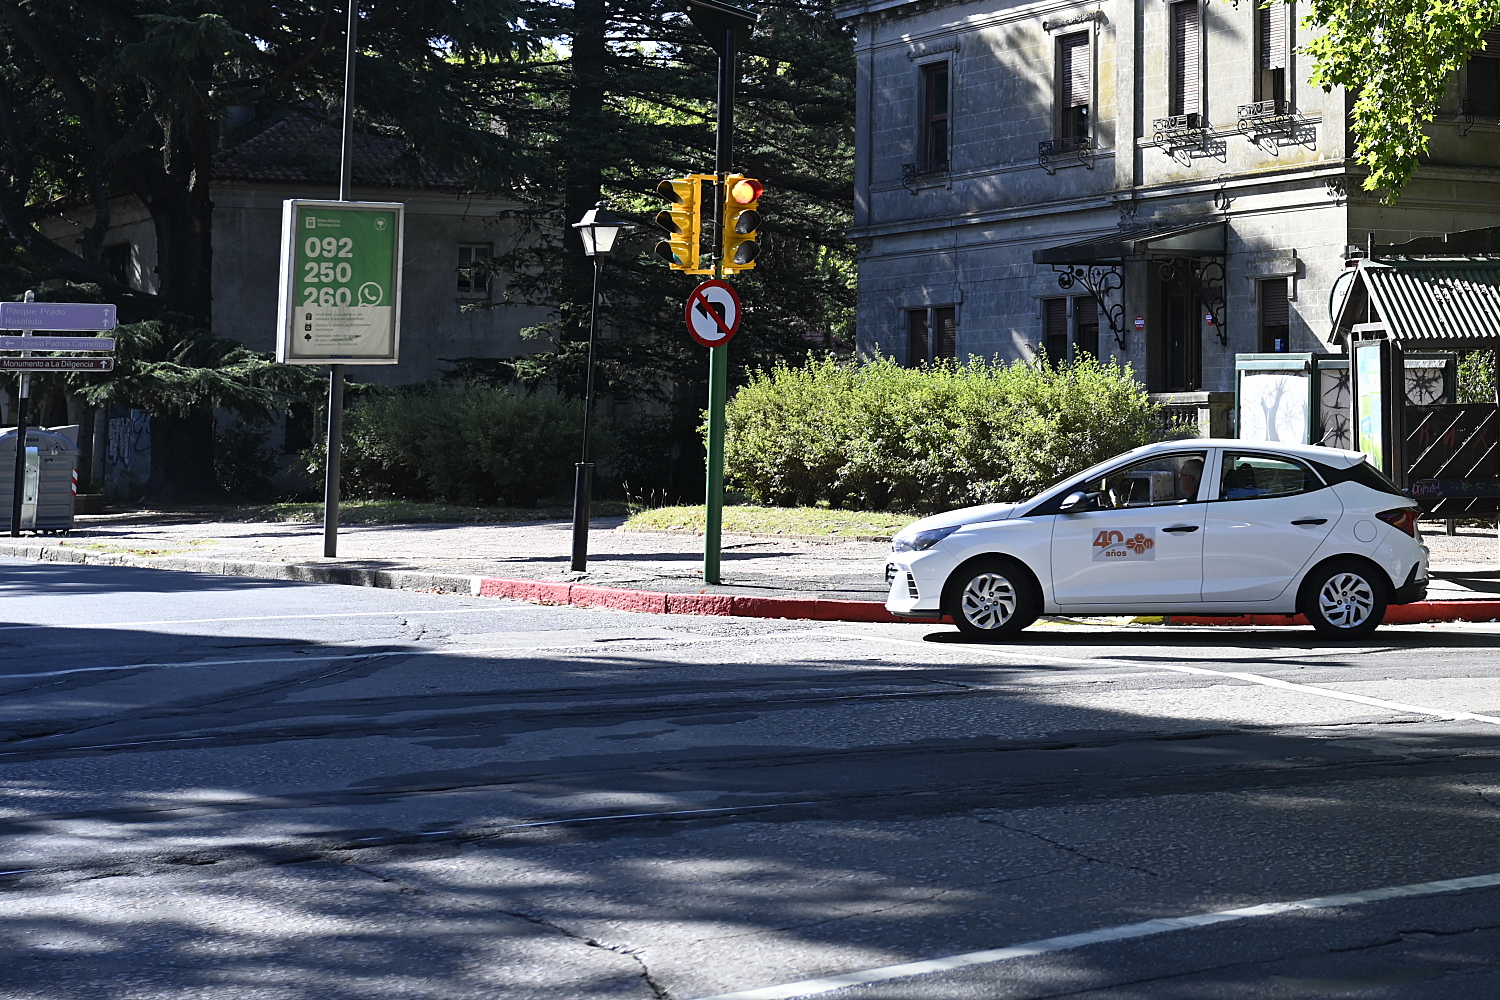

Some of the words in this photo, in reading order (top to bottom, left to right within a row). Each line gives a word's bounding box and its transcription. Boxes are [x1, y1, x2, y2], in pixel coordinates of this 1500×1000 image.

[305, 237, 353, 258] 092
[303, 262, 352, 283] 250
[303, 286, 352, 307] 260
[6, 307, 37, 316] Parque
[21, 340, 44, 348] Iglesia
[61, 360, 94, 369] Diligencia
